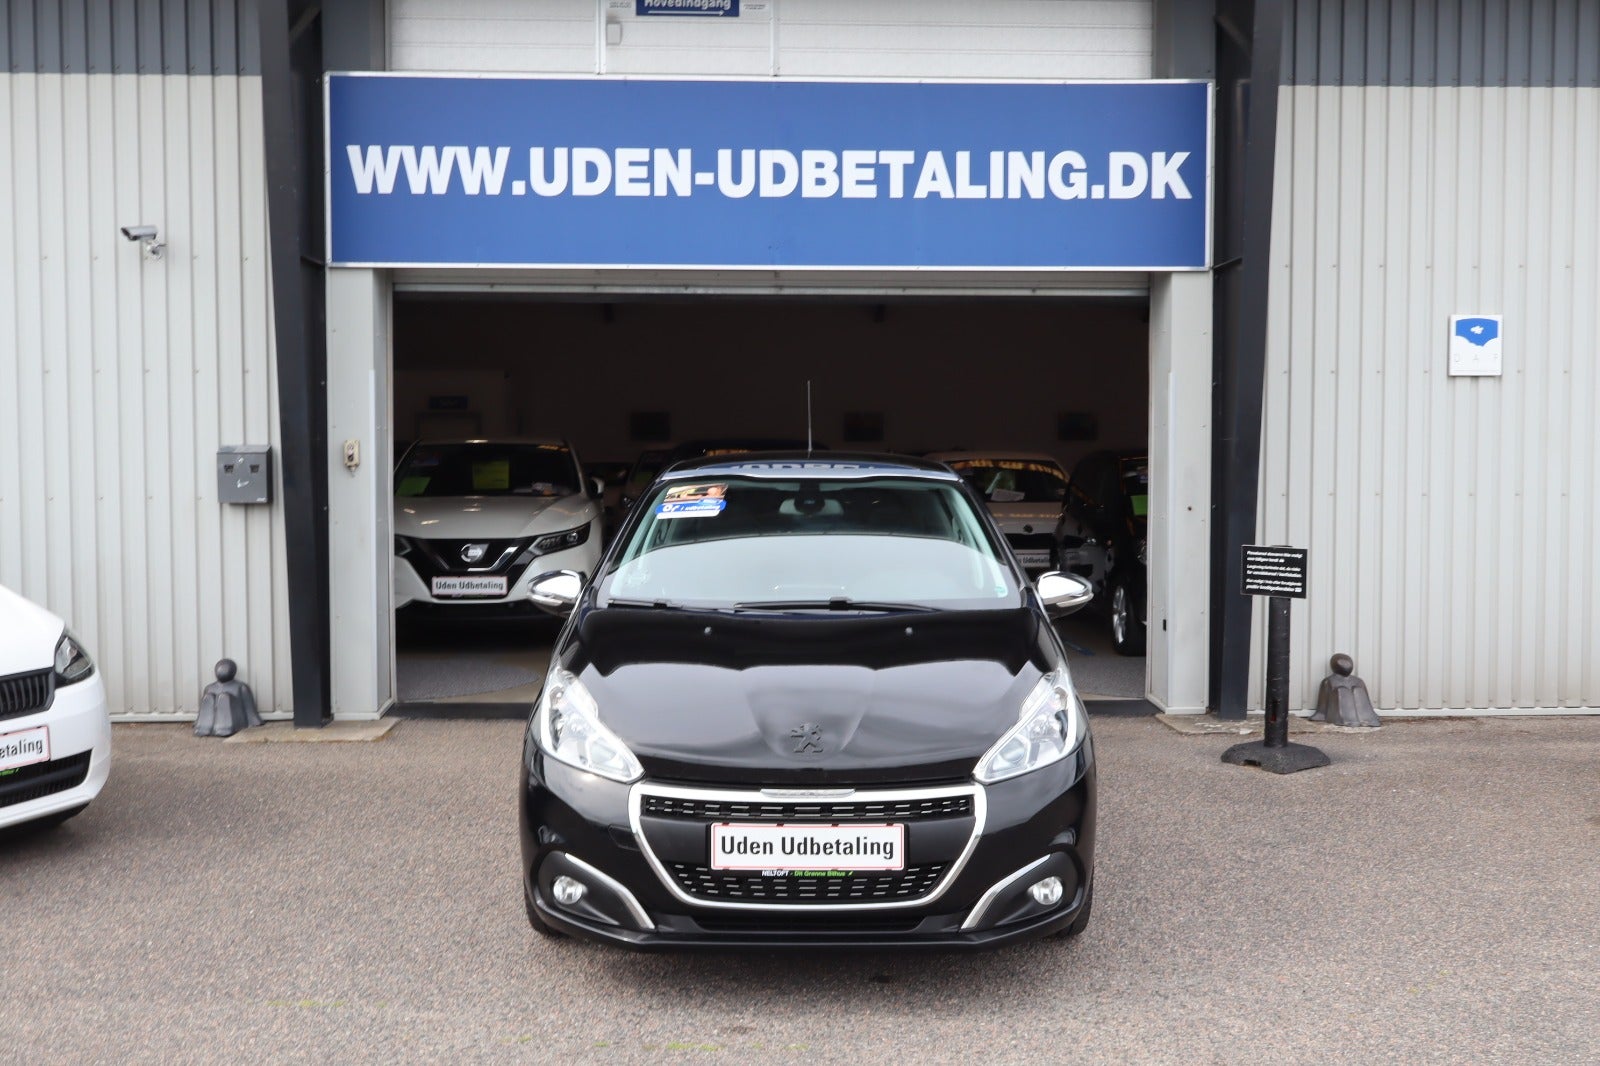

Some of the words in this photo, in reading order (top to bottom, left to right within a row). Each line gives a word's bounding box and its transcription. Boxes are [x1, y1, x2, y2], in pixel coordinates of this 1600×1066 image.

[347, 145, 1192, 200] WWW.UDEN-UDBETALING.DK
[436, 581, 457, 590] Uden
[459, 581, 504, 591] Udbetaling
[721, 836, 774, 855] Uden
[781, 836, 894, 860] Udbetaling
